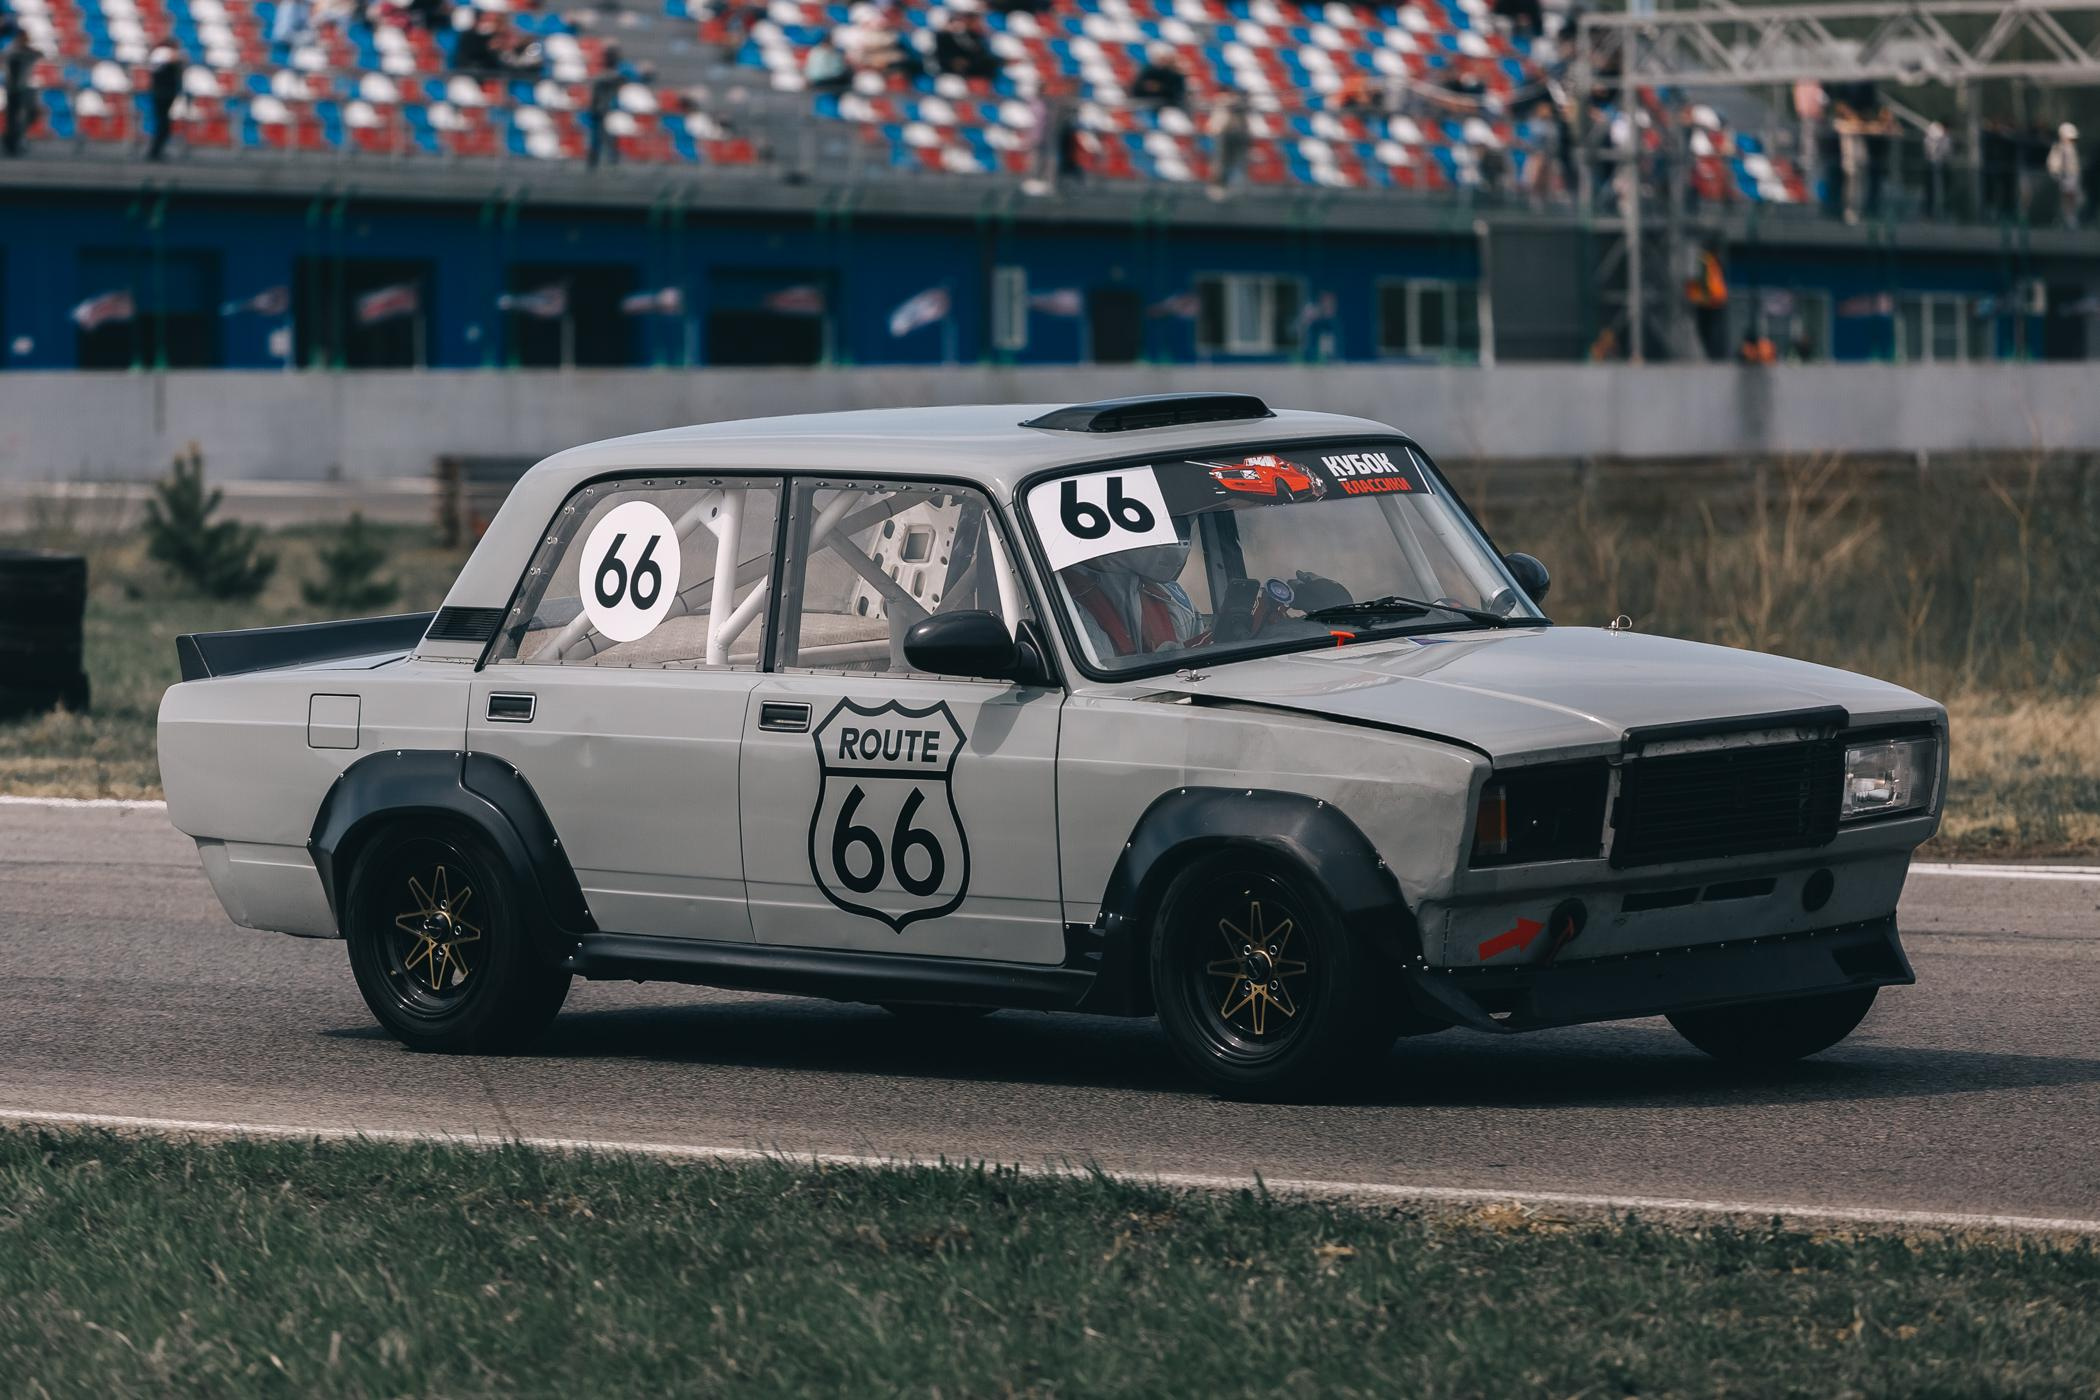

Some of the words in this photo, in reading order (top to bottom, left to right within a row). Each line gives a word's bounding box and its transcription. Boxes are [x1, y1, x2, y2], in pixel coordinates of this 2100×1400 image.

[1321, 453, 1399, 477] КУБОК
[1340, 477, 1412, 495] КЛАССИКИ
[1060, 476, 1155, 540] 66
[594, 533, 662, 610] 66
[838, 727, 941, 763] ROUTE
[832, 784, 945, 897] 66
